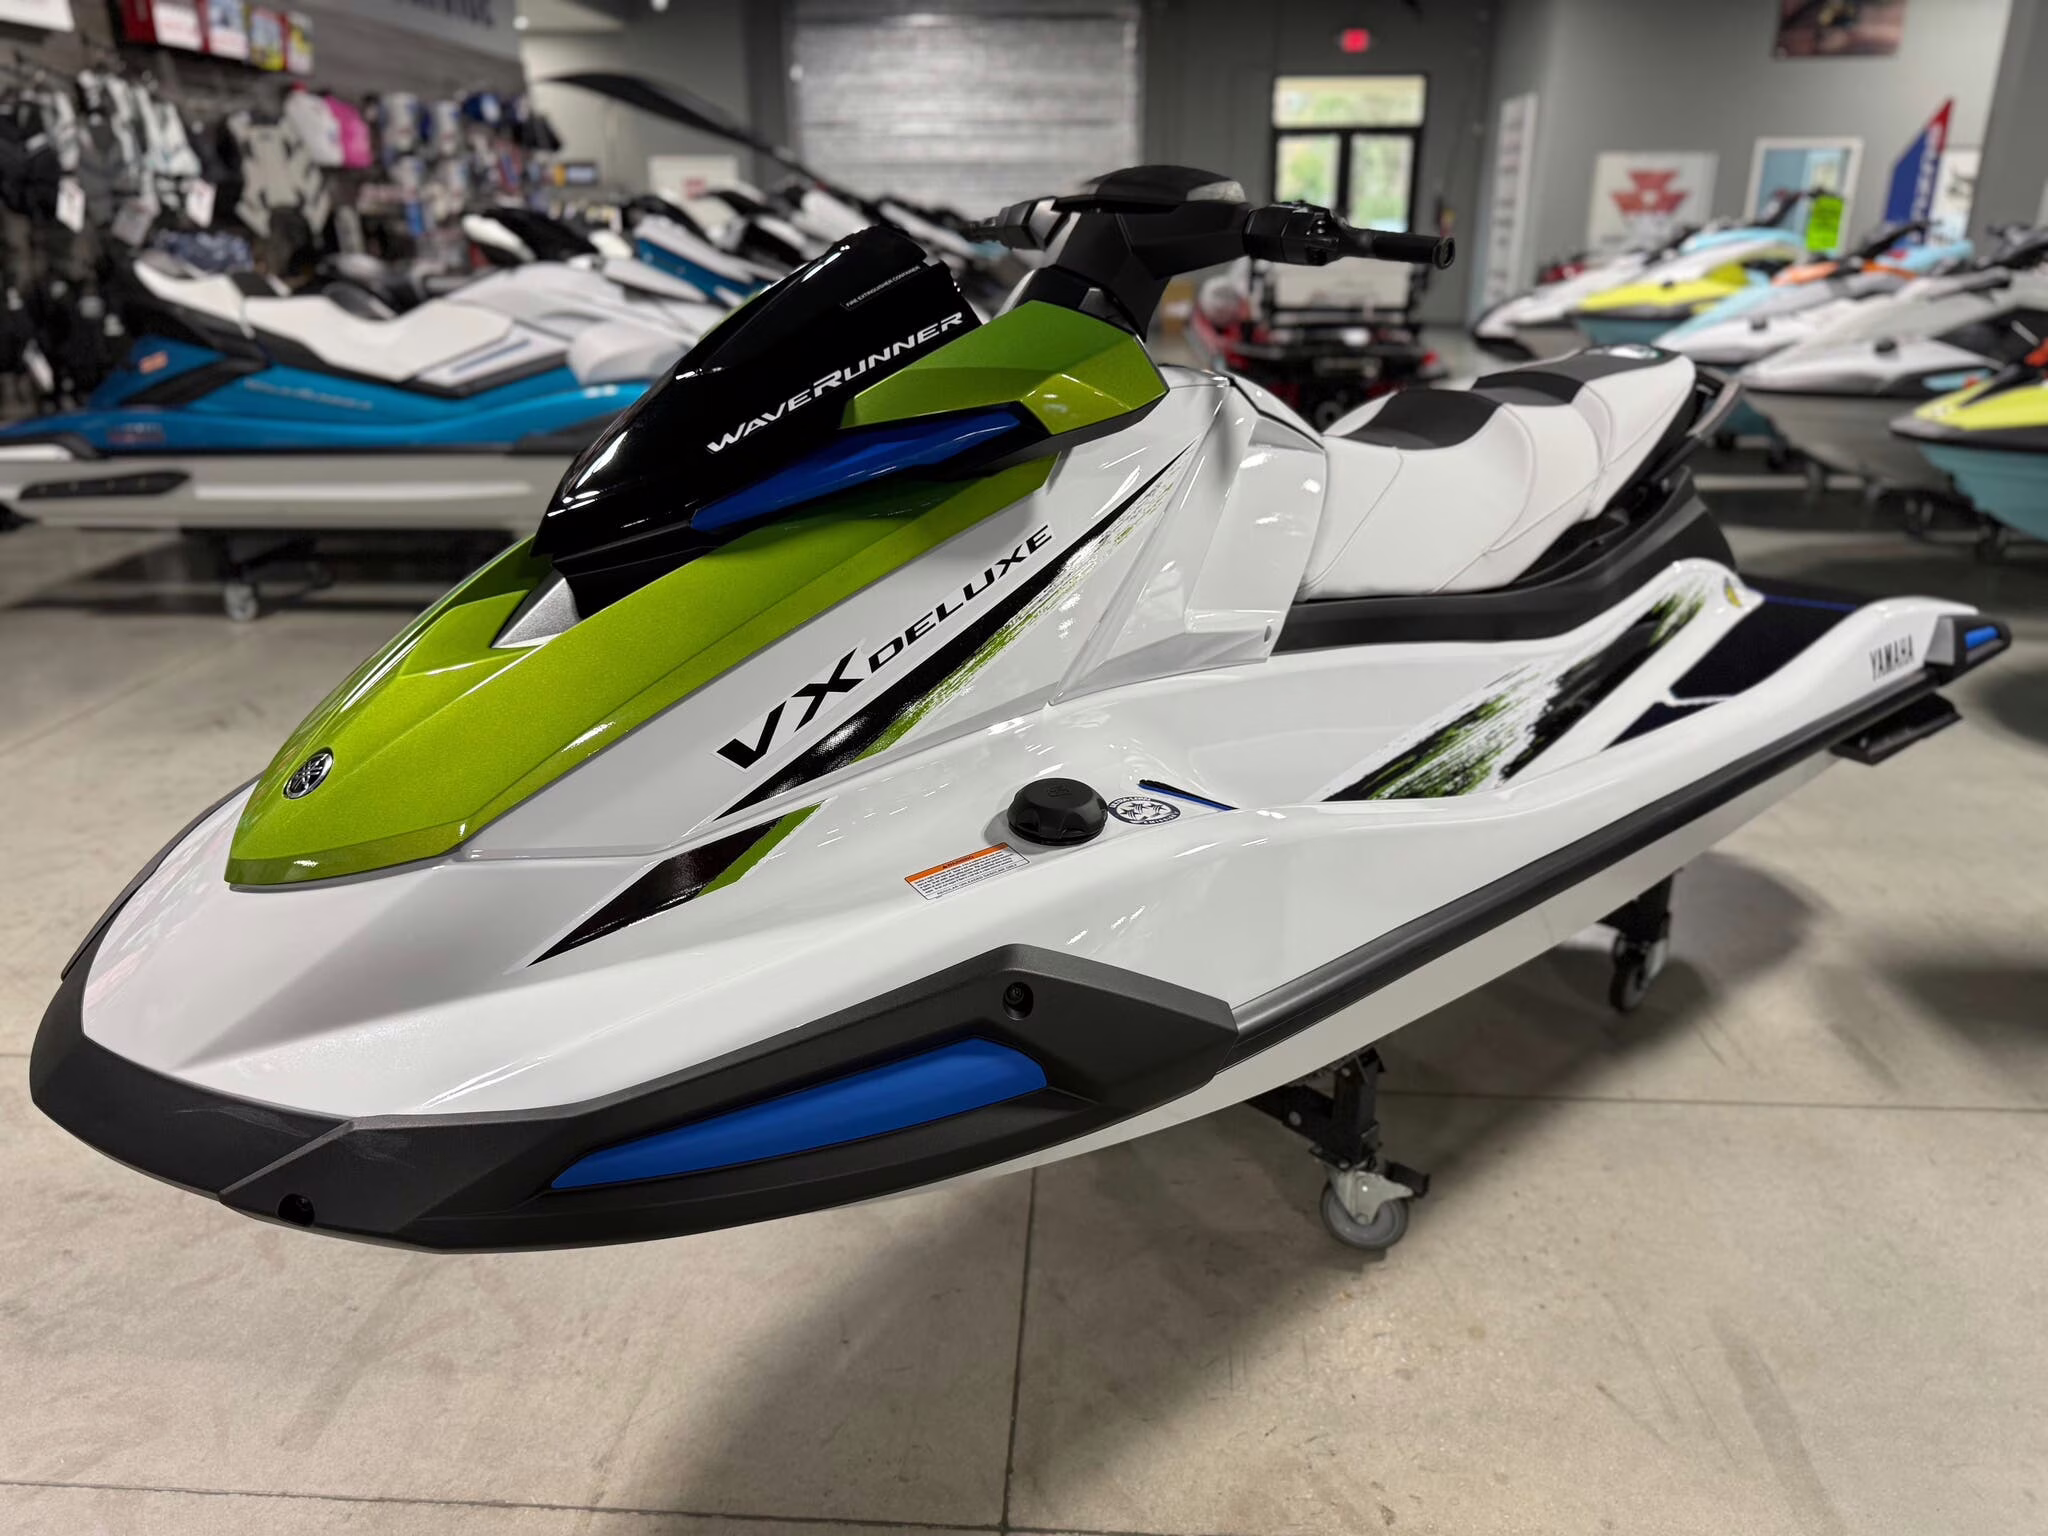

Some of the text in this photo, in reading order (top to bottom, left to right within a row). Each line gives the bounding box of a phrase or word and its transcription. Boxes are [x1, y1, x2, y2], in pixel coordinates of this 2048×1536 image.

[706, 311, 963, 454] WAVERUNNER
[716, 524, 1053, 770] VX DELUXE
[1869, 634, 1914, 681] YAMAHA
